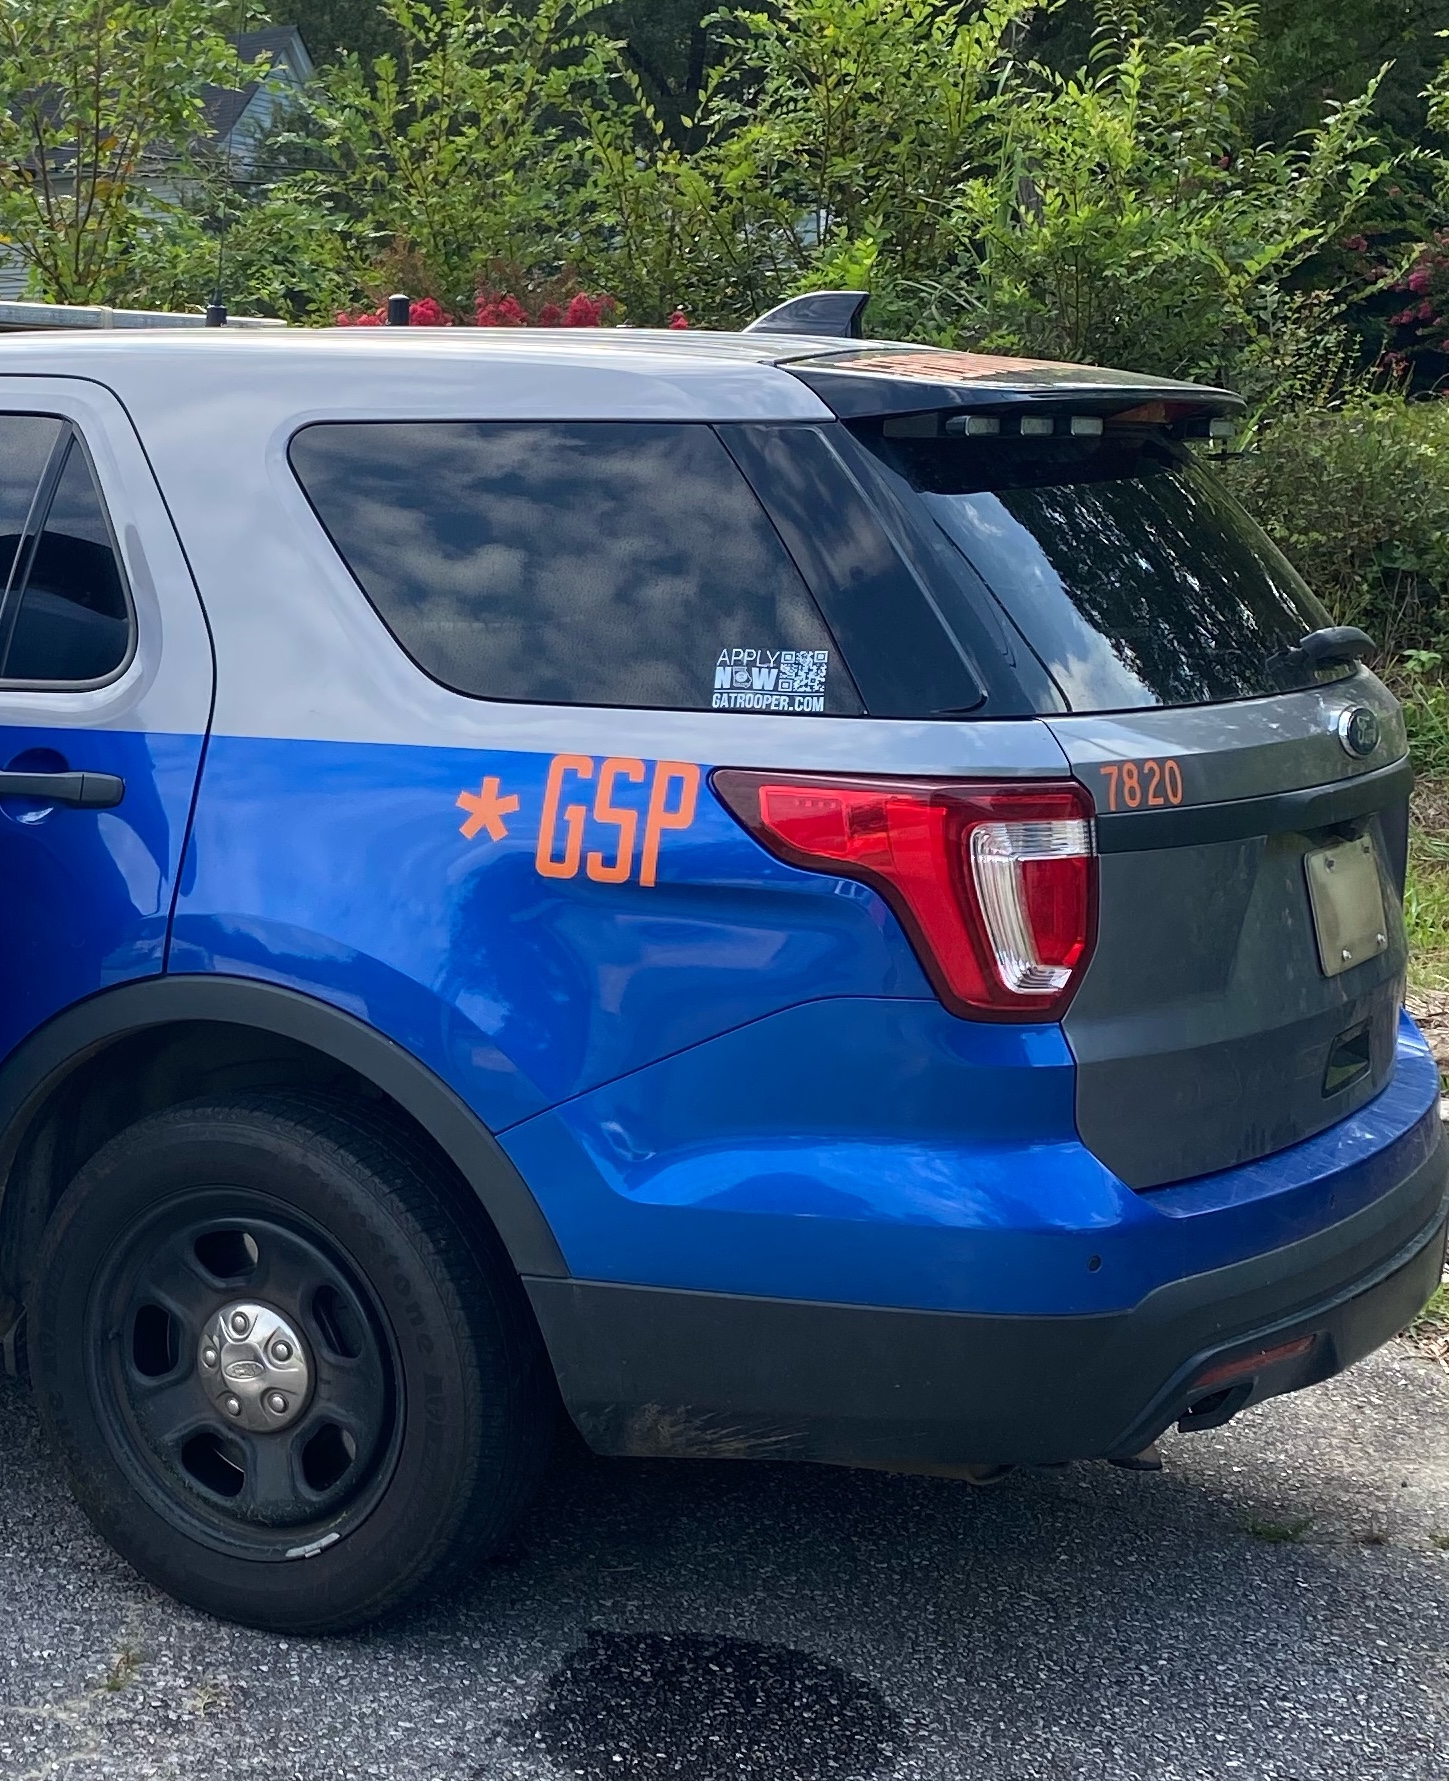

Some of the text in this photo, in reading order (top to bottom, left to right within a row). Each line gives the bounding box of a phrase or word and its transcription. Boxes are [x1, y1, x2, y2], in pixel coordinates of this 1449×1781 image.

[716, 648, 780, 667] APPLY
[712, 693, 824, 711] GATROOPER.COM
[1099, 759, 1183, 811] 7820
